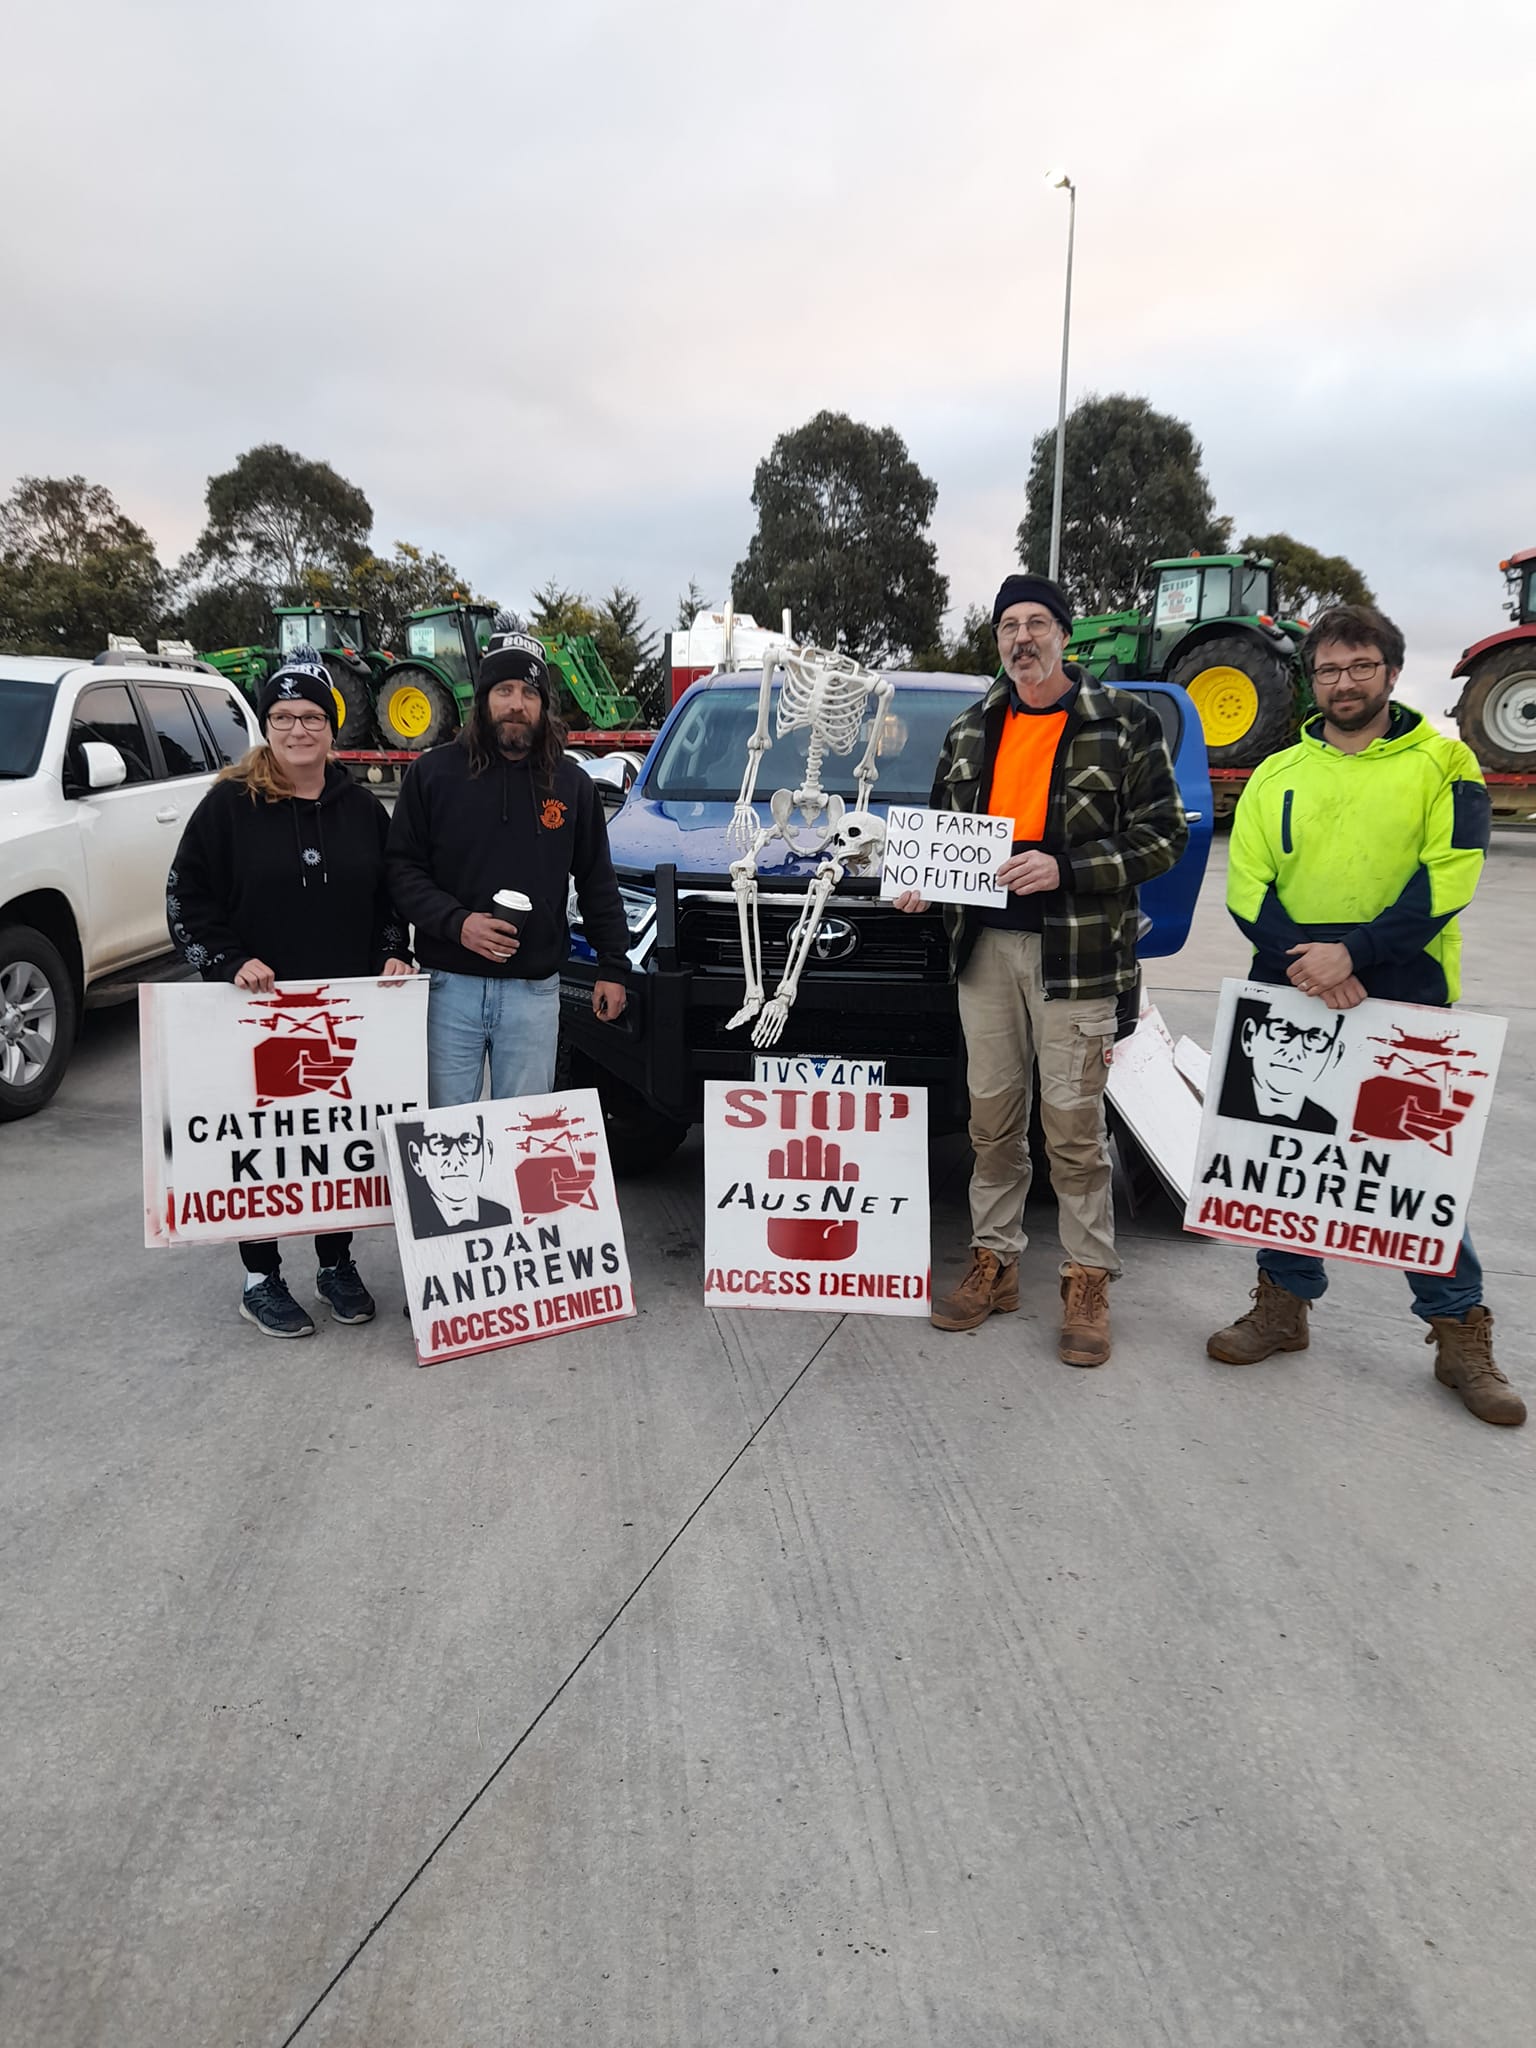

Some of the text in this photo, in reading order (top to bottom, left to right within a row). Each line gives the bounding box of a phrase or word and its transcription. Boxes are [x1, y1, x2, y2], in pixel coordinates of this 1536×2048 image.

[890, 811, 1008, 839] NO FARMS
[886, 839, 992, 865] NO FOOD
[883, 865, 918, 886] NO
[724, 1089, 910, 1132] STOP
[231, 1139, 375, 1183] KING
[1269, 1134, 1391, 1178] DAN
[180, 1175, 393, 1225] ACCESS DENI
[1201, 1153, 1457, 1228] ANDREWS
[464, 1224, 562, 1263] DAN
[1198, 1196, 1445, 1267] ACCESS DENIED
[421, 1242, 620, 1311] ANDREWS
[704, 1268, 924, 1299] ACCESS DENIED
[431, 1284, 624, 1351] ACCESS DENIED
